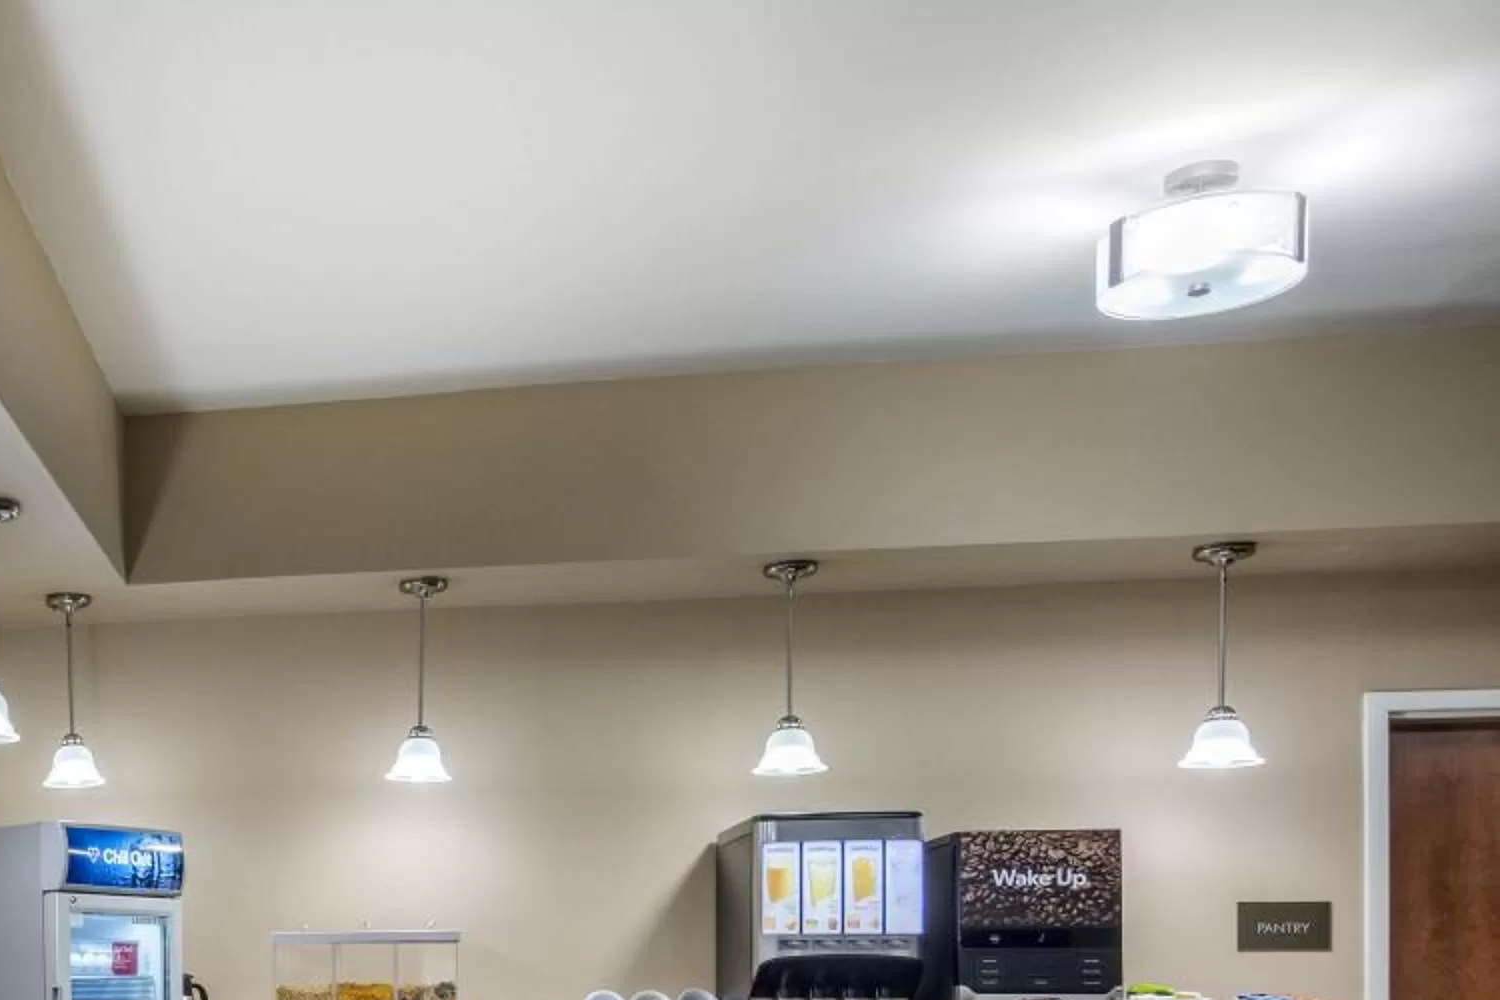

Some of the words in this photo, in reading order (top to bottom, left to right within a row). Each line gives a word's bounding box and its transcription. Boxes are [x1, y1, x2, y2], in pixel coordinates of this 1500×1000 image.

[991, 868, 1053, 887] Wake
[1056, 867, 1087, 890] Up
[1257, 922, 1311, 934] PANTRY
